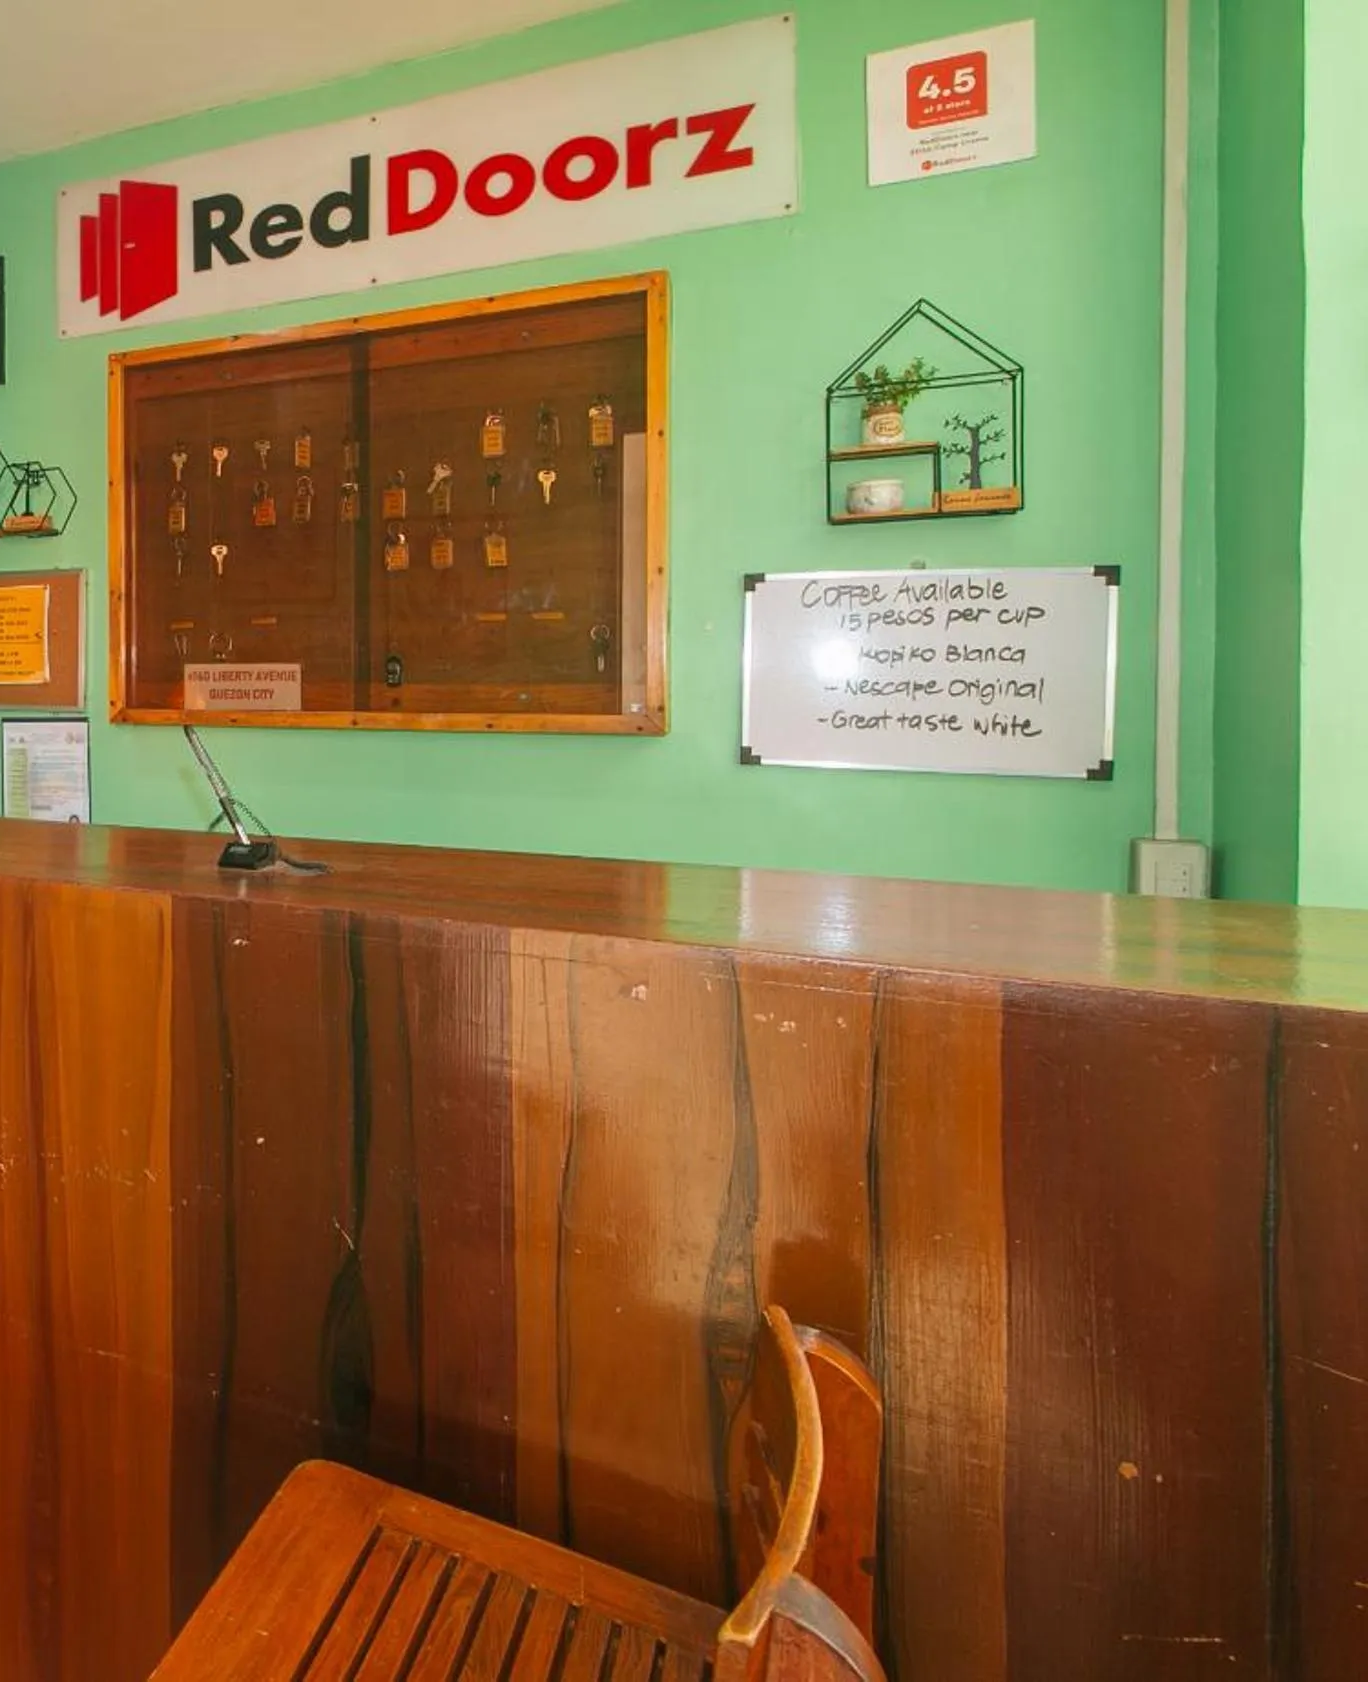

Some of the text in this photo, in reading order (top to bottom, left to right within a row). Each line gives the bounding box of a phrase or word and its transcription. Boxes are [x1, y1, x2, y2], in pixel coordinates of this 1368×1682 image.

[918, 66, 977, 99] 4.5
[192, 102, 756, 272] RedDoorz
[839, 613, 863, 632] 15
[866, 606, 934, 633] pesos
[945, 607, 991, 632] per
[946, 644, 1026, 665] Blanca
[212, 670, 254, 683] LIBERTY
[255, 669, 297, 682] AVENUE
[209, 687, 275, 701] QUEZON CITY
[948, 677, 1044, 706] Original
[896, 712, 963, 733] taste
